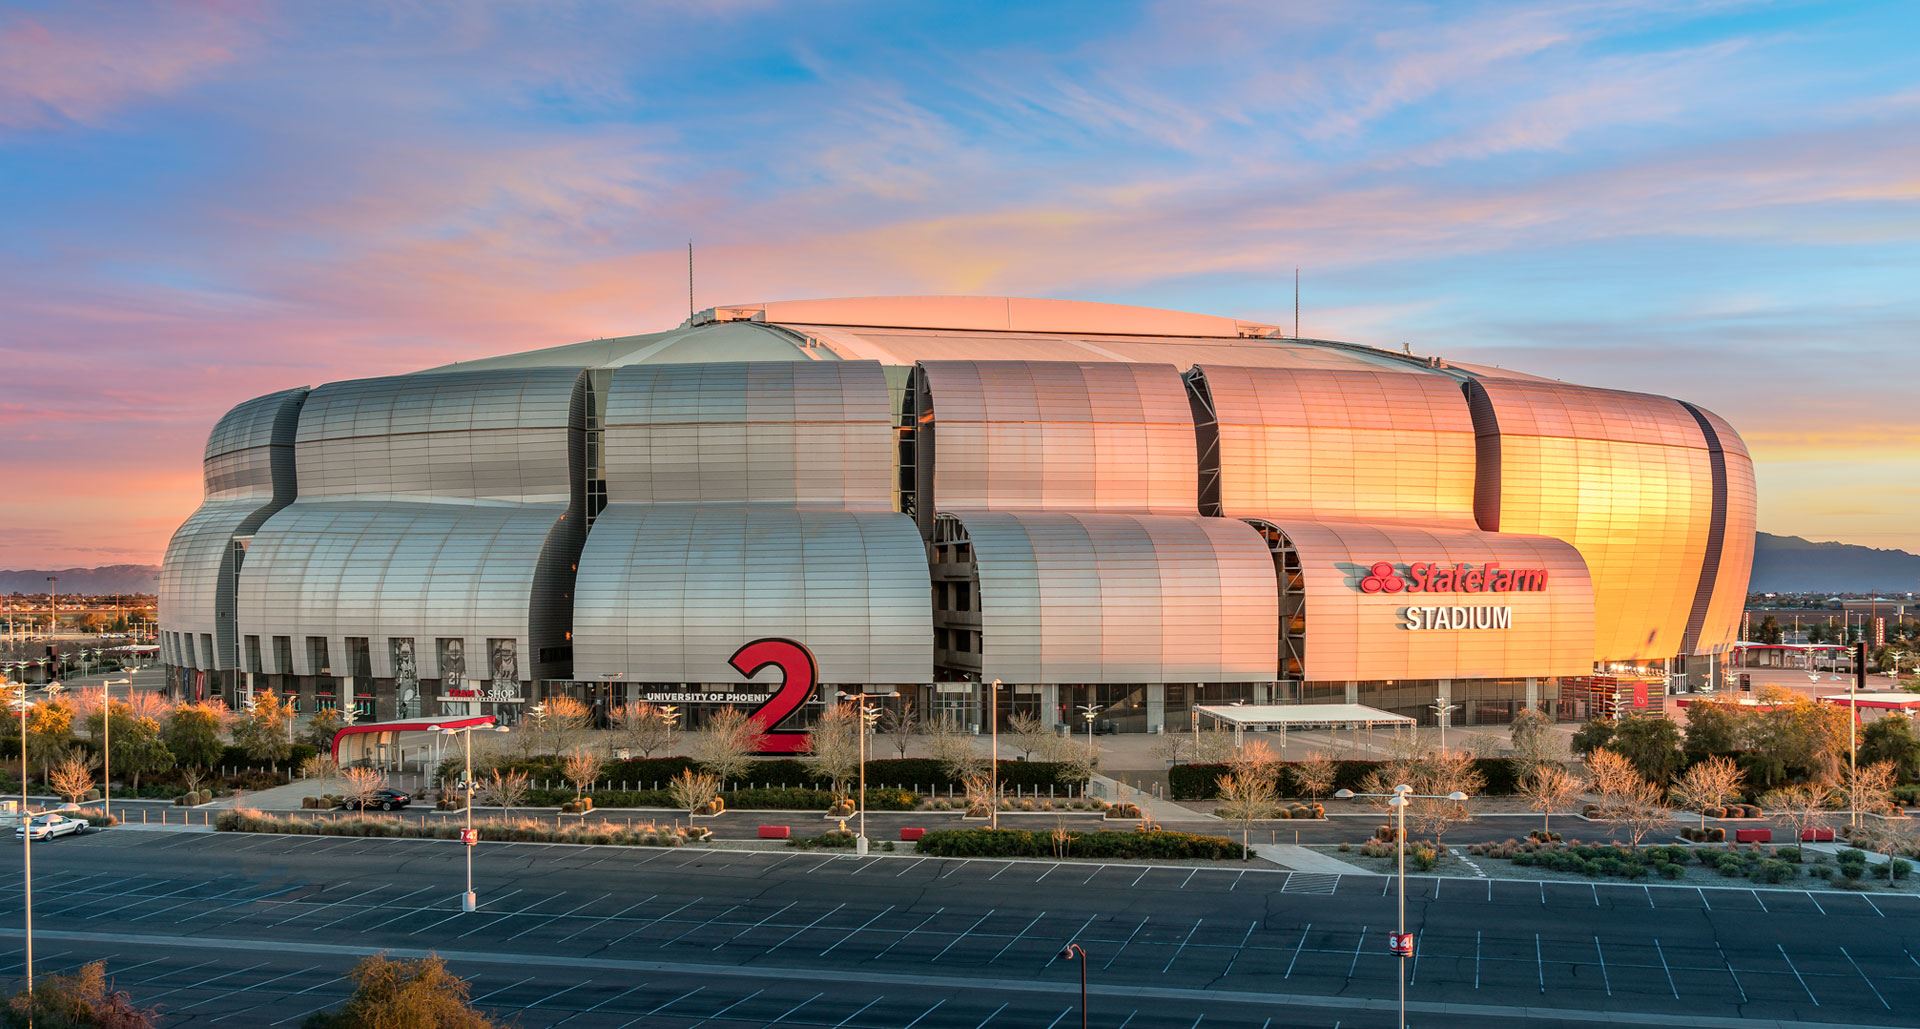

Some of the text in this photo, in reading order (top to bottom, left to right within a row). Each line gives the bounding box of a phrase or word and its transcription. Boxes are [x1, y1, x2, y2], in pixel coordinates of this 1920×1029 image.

[1405, 606, 1512, 630] STADIUM
[448, 671, 459, 685] 21
[449, 688, 515, 699] TEAM SHOP
[647, 693, 708, 701] UNIVERSITY
[709, 693, 724, 701] OF
[728, 638, 818, 755] 2
